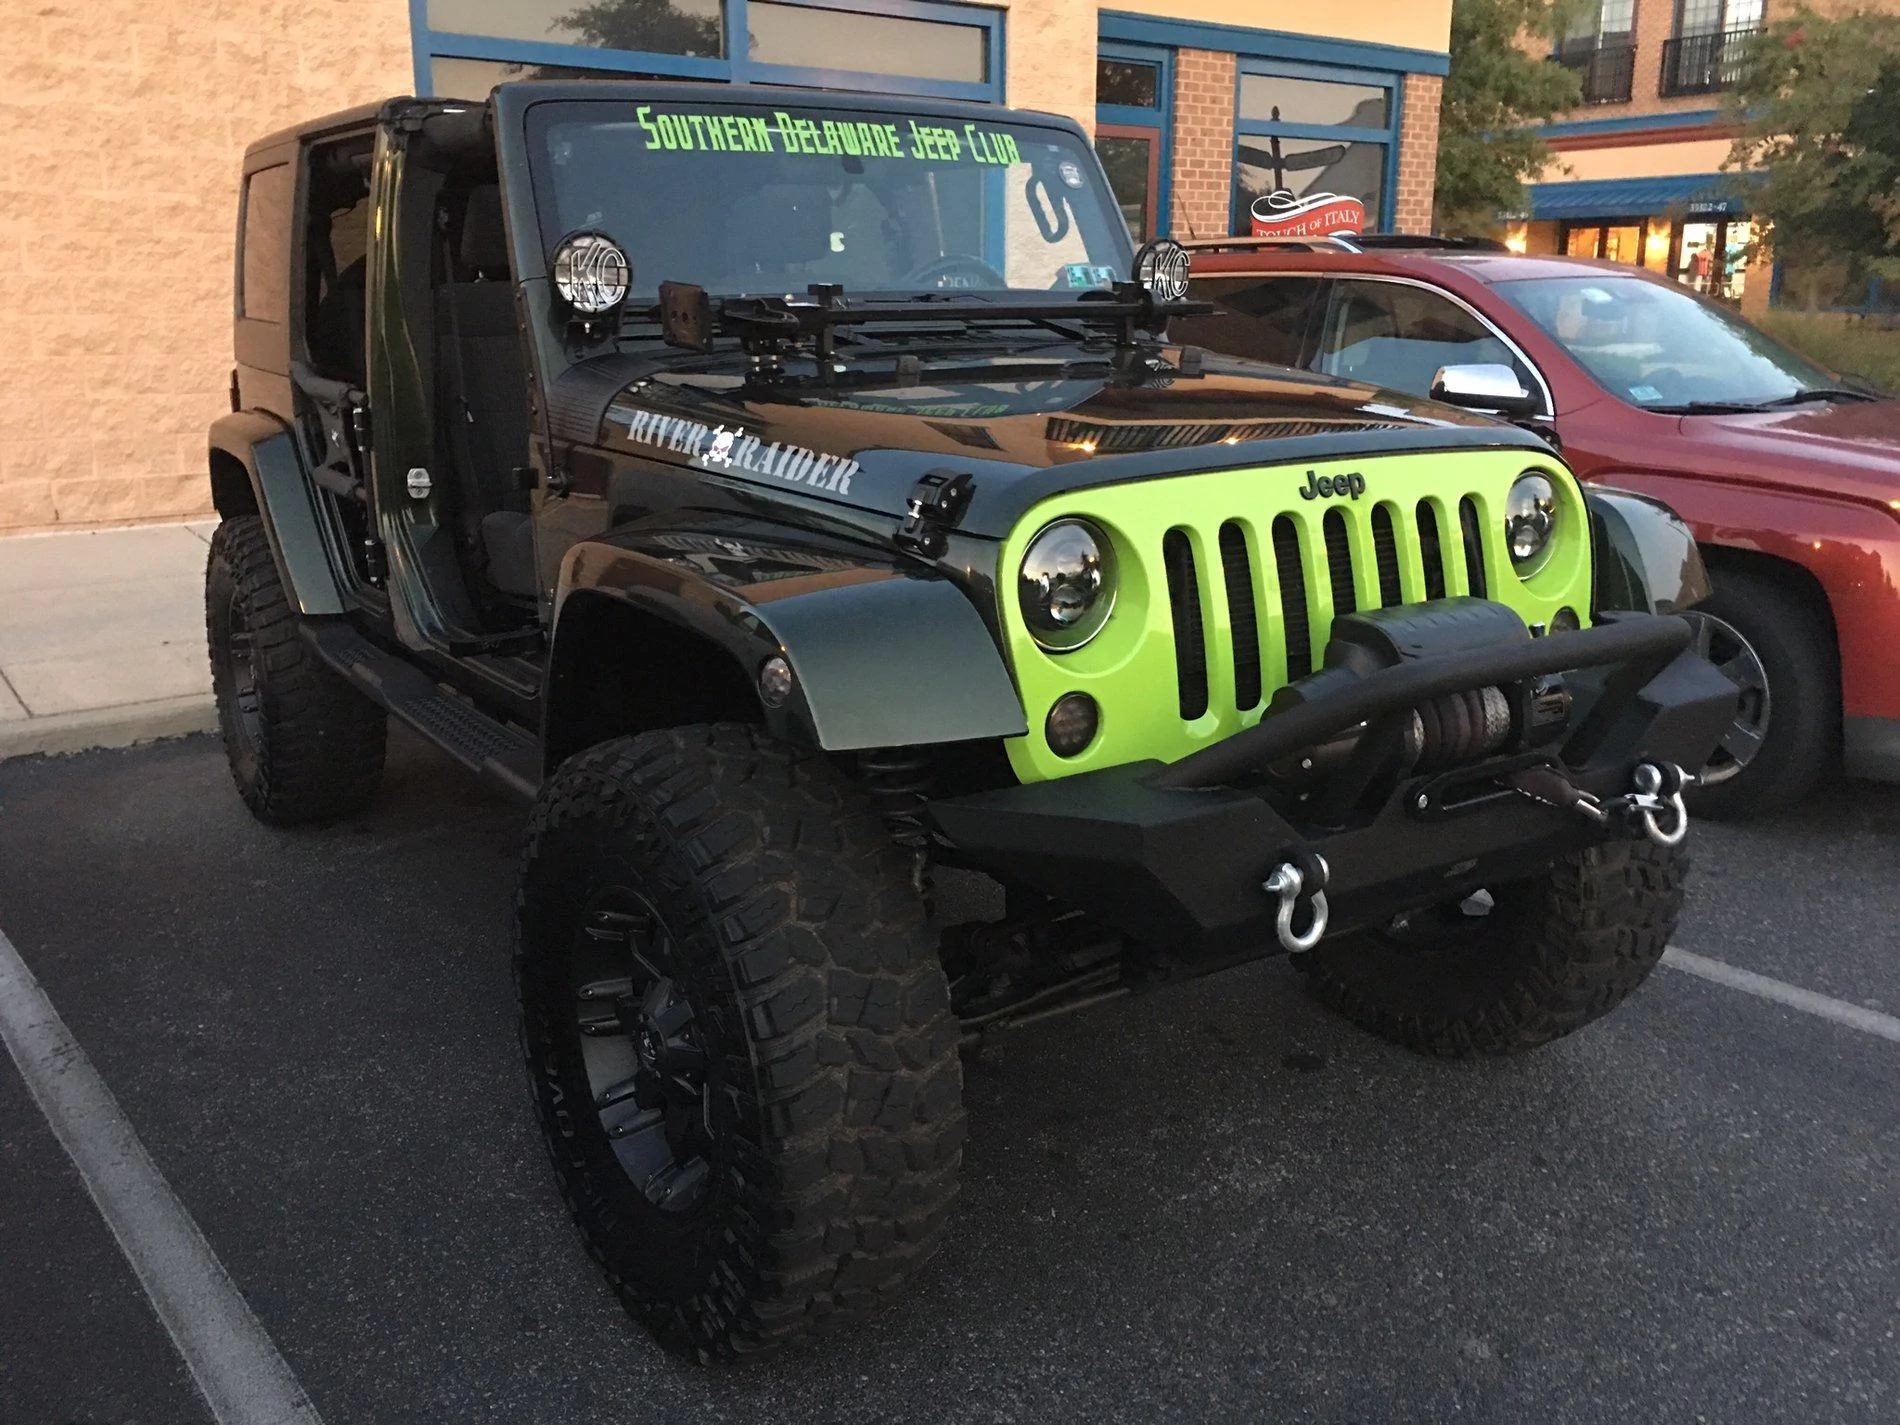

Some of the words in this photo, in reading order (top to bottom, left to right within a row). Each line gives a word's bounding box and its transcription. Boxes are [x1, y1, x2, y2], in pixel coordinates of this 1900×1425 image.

[1309, 218, 1322, 231] OF
[1324, 209, 1360, 227] ITALY
[627, 410, 708, 457] RIVER
[733, 435, 860, 495] RAIDER
[1299, 470, 1366, 501] Jeep
